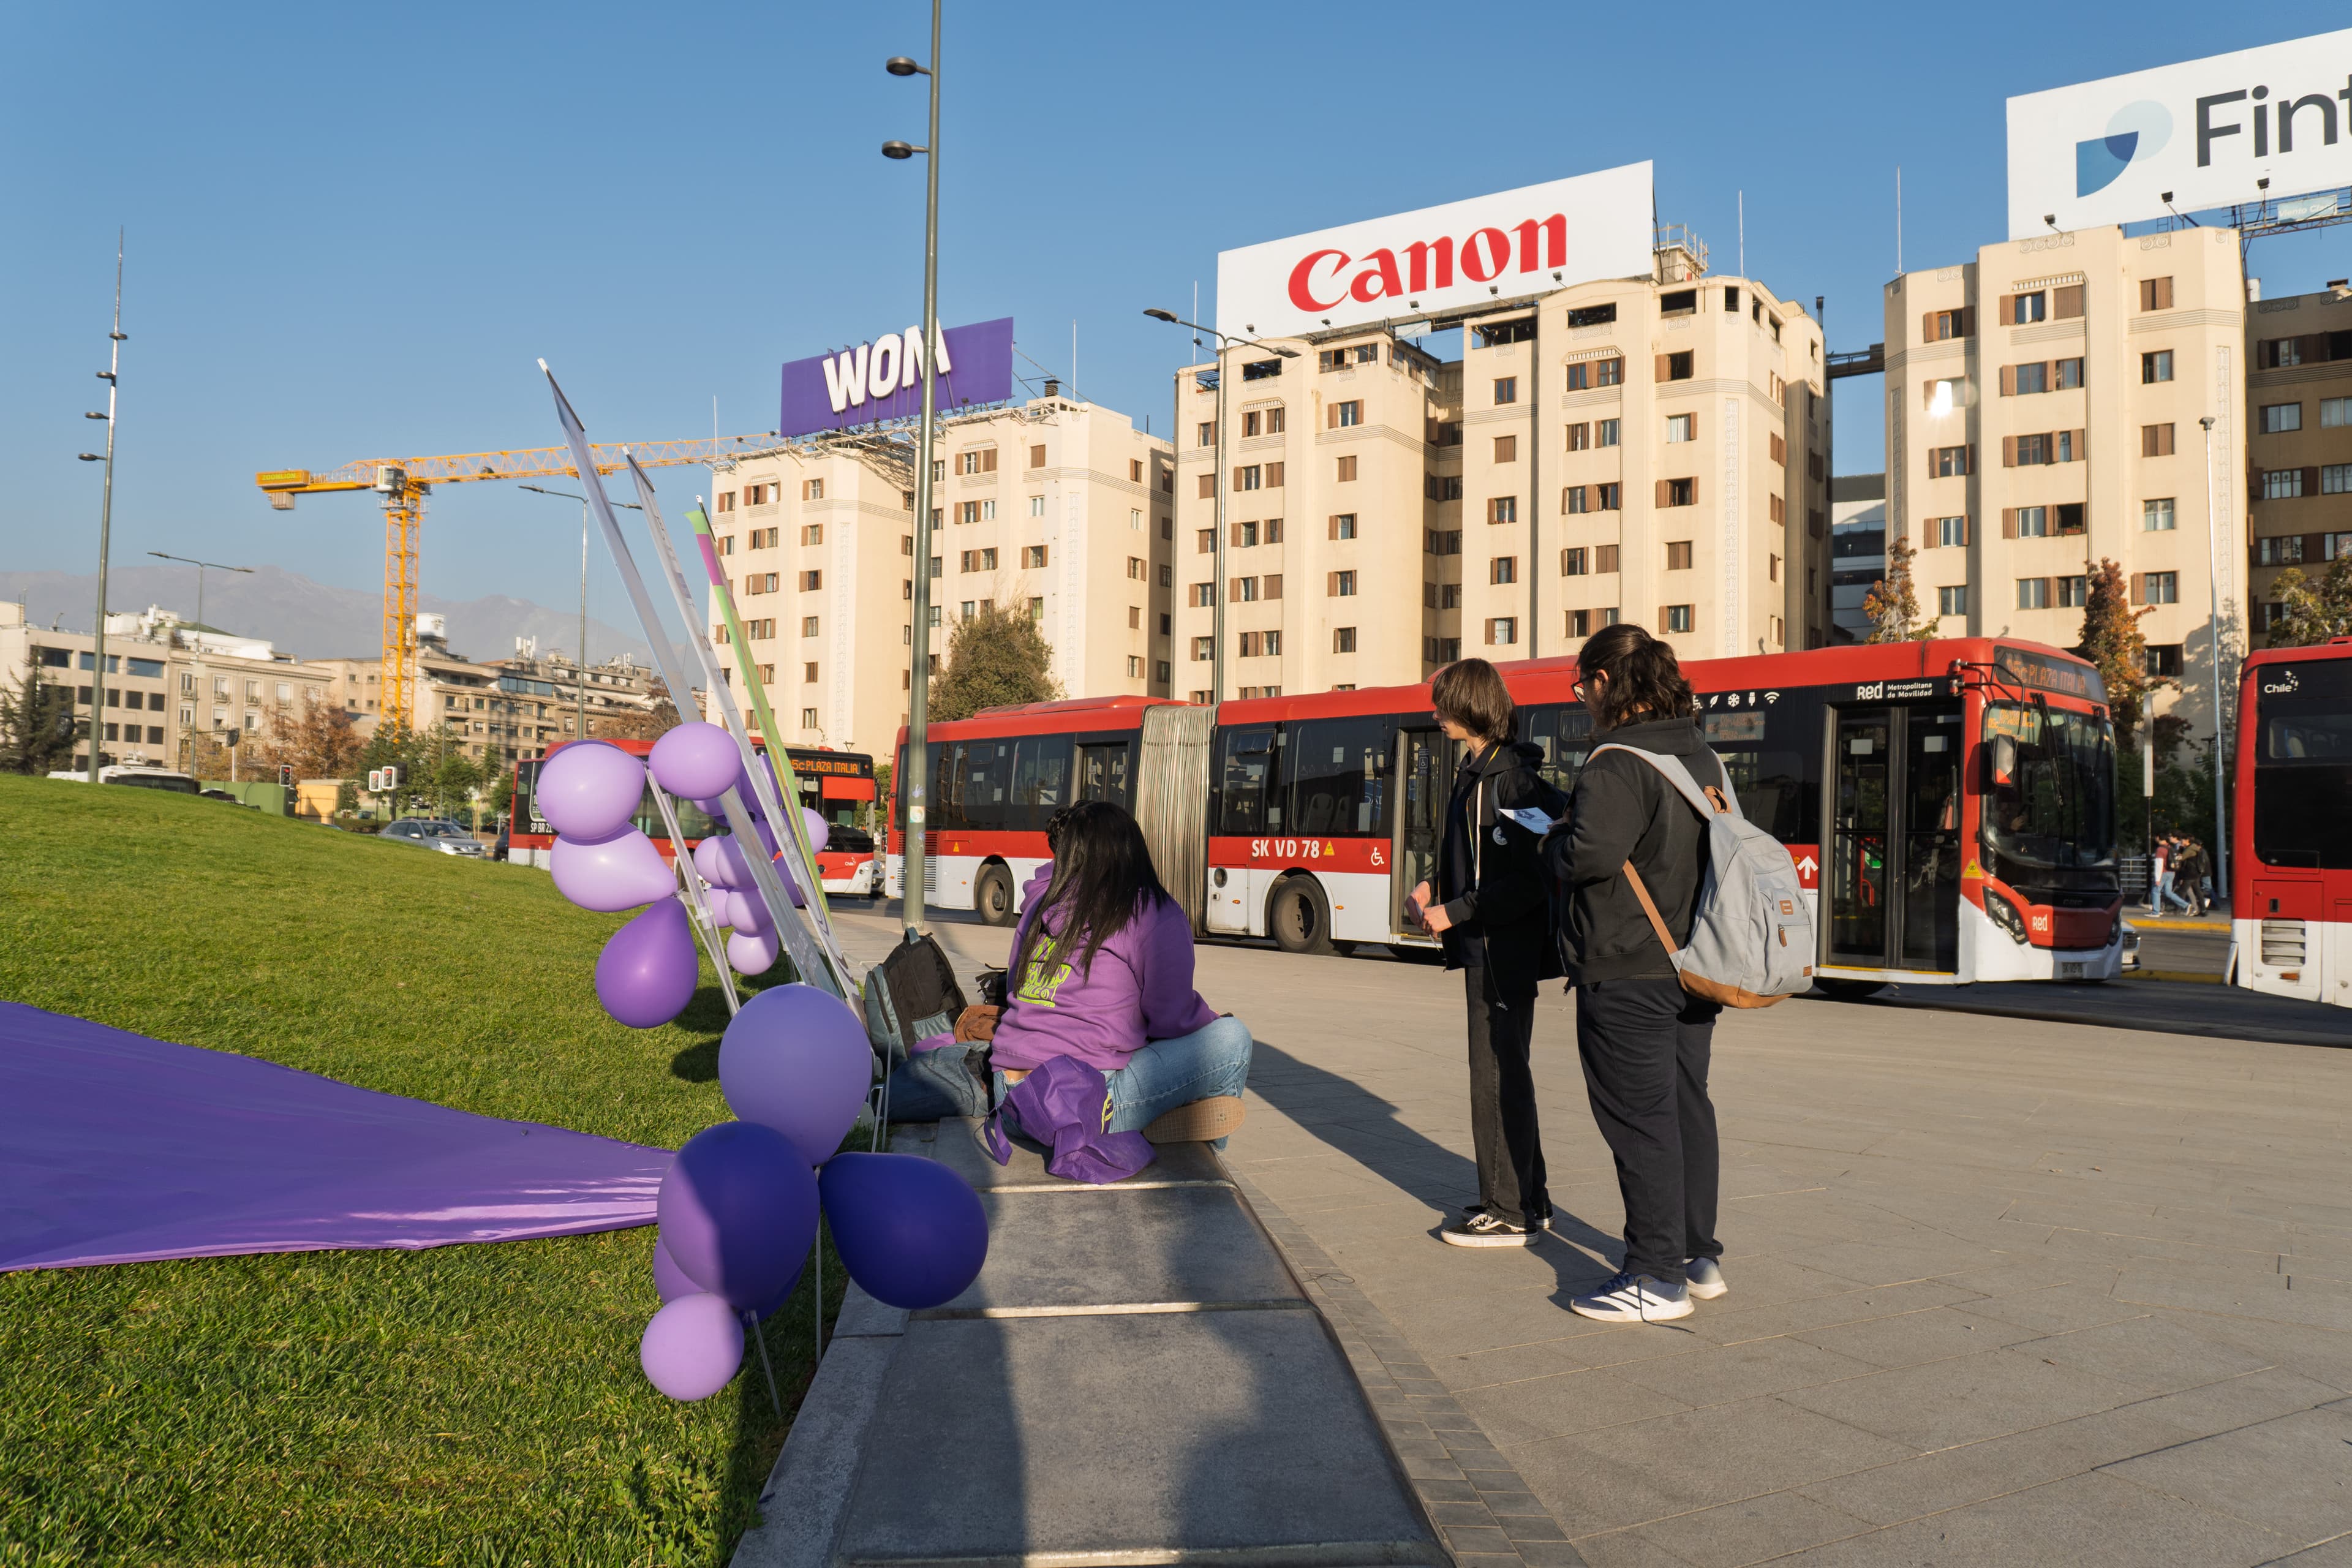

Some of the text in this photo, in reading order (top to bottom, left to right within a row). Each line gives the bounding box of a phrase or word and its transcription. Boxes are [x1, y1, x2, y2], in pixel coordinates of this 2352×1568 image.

[1288, 213, 1567, 312] Canon
[823, 317, 951, 413] WOM
[1887, 682, 1932, 691] Metropolitana
[2028, 663, 2058, 689] PLAZA
[2060, 671, 2086, 695] ITALIA
[1857, 681, 1883, 700] Red
[1898, 688, 1933, 698] Movilidad
[2264, 684, 2292, 693] Chile
[790, 759, 859, 774] 5c PLAZA ITALIA
[530, 822, 537, 833] SP
[538, 822, 545, 833] BR
[1251, 839, 1320, 858] SK VD 78
[2032, 914, 2048, 932] Red
